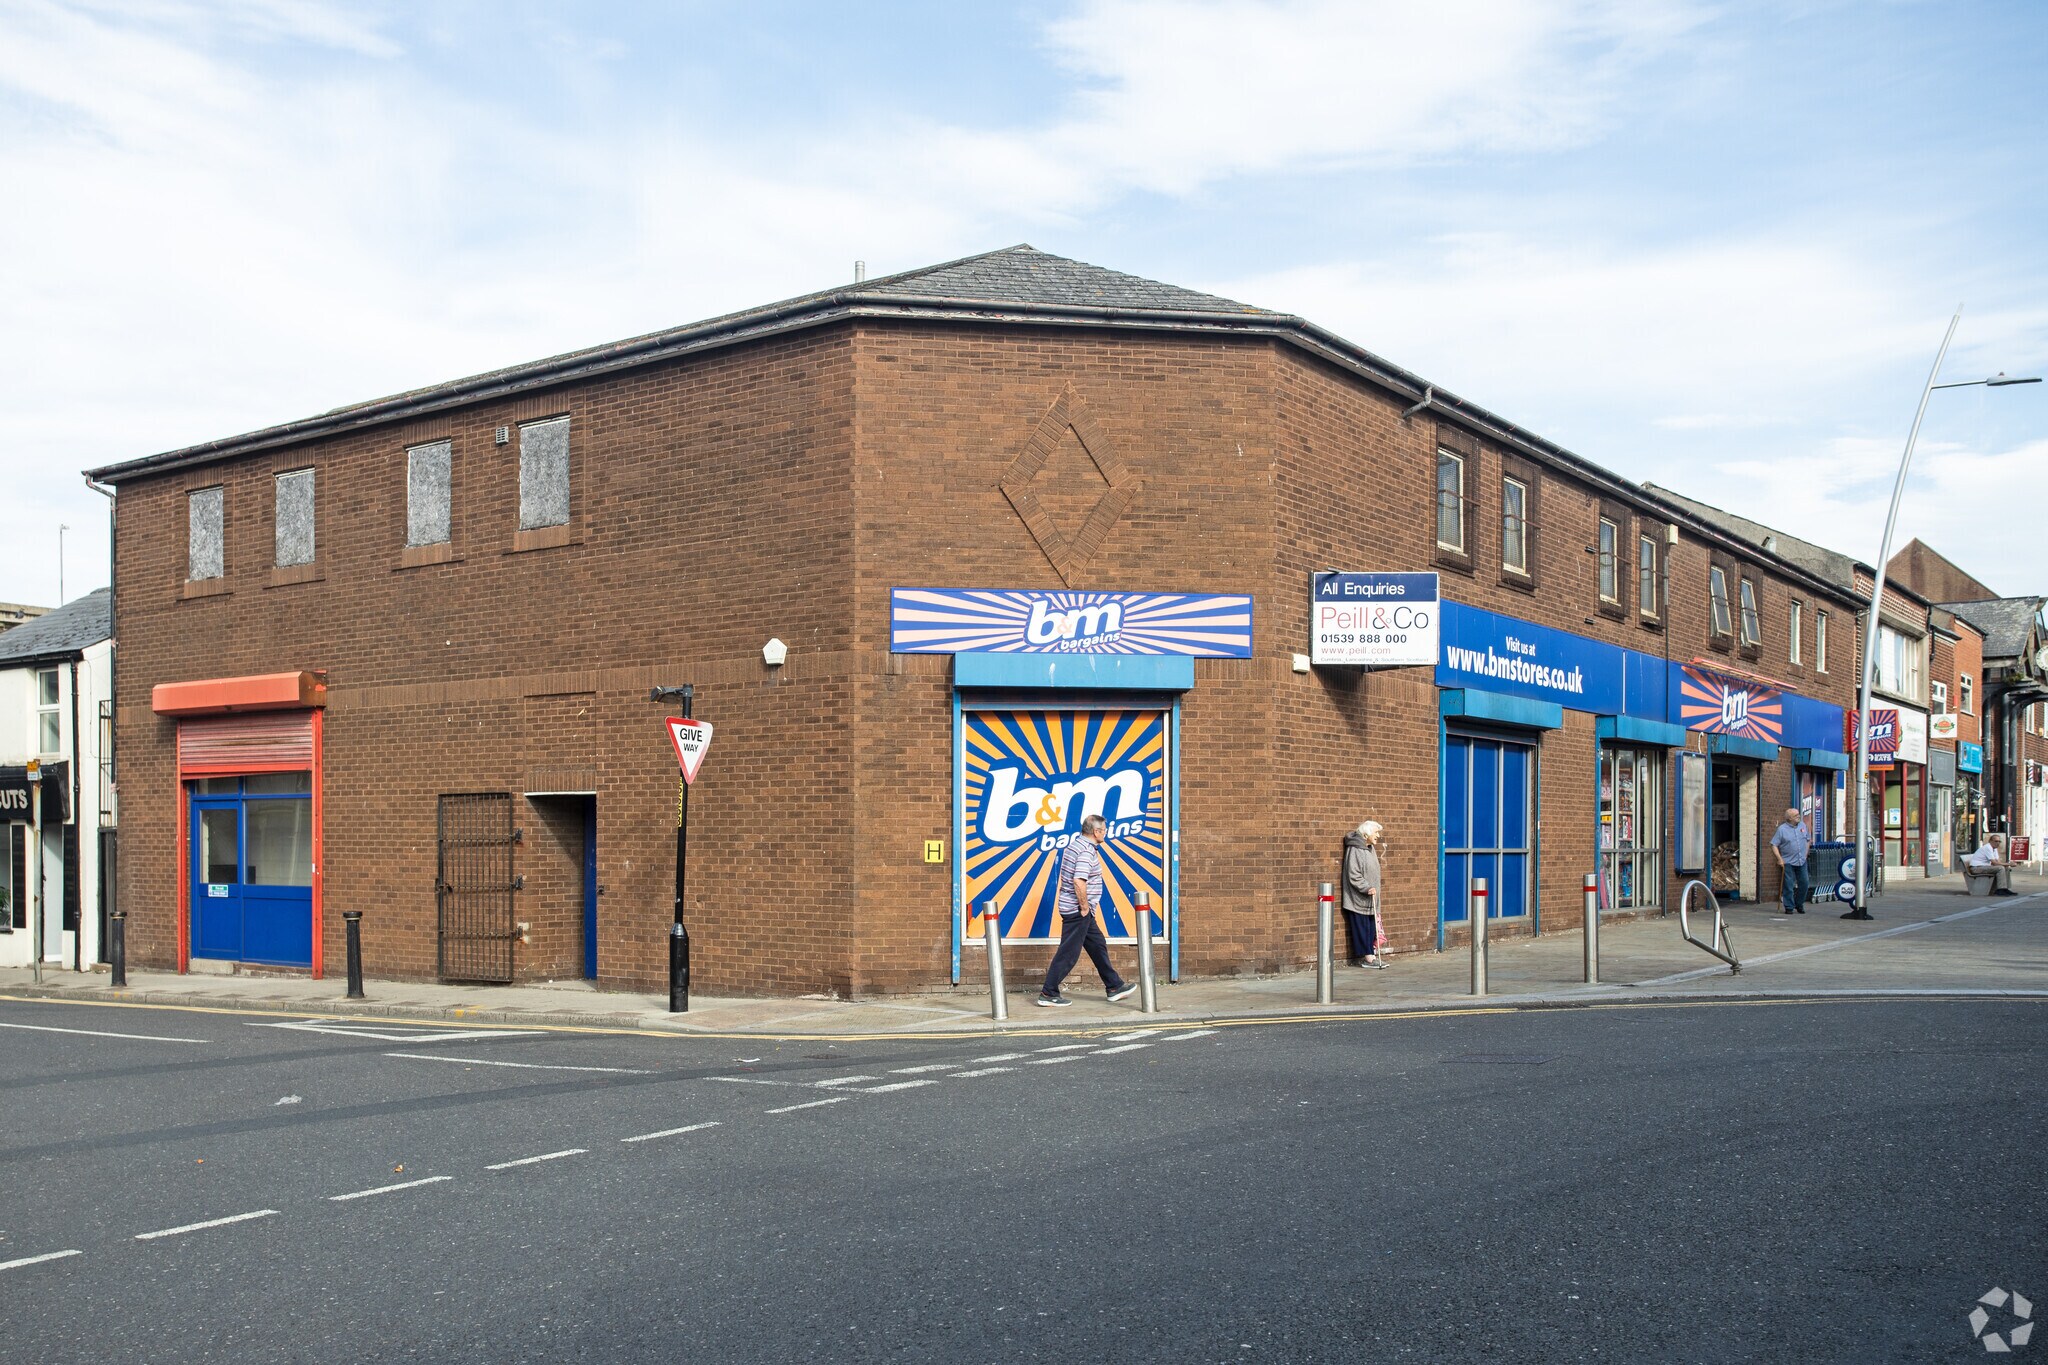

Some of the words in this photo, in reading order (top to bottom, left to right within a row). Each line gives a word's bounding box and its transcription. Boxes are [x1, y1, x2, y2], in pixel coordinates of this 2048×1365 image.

[1322, 582, 1338, 595] All
[1344, 582, 1405, 598] Enquiries
[1027, 599, 1122, 645] b&m
[1060, 632, 1121, 651] bargains
[1321, 634, 1354, 643] 01539
[1359, 634, 1381, 643] 888
[1385, 634, 1407, 643] 000
[1505, 636, 1521, 653] Visit
[1521, 644, 1529, 655] us
[1528, 643, 1536, 657] at
[1321, 647, 1391, 656] www.peill.com
[1446, 645, 1583, 694] www.bmstores.co.uk
[680, 728, 703, 742] GIVE
[683, 743, 699, 752] WAY
[0, 789, 28, 810] UTS
[983, 767, 1147, 843] b&m
[1041, 820, 1143, 851] barins
[927, 843, 941, 860] H
